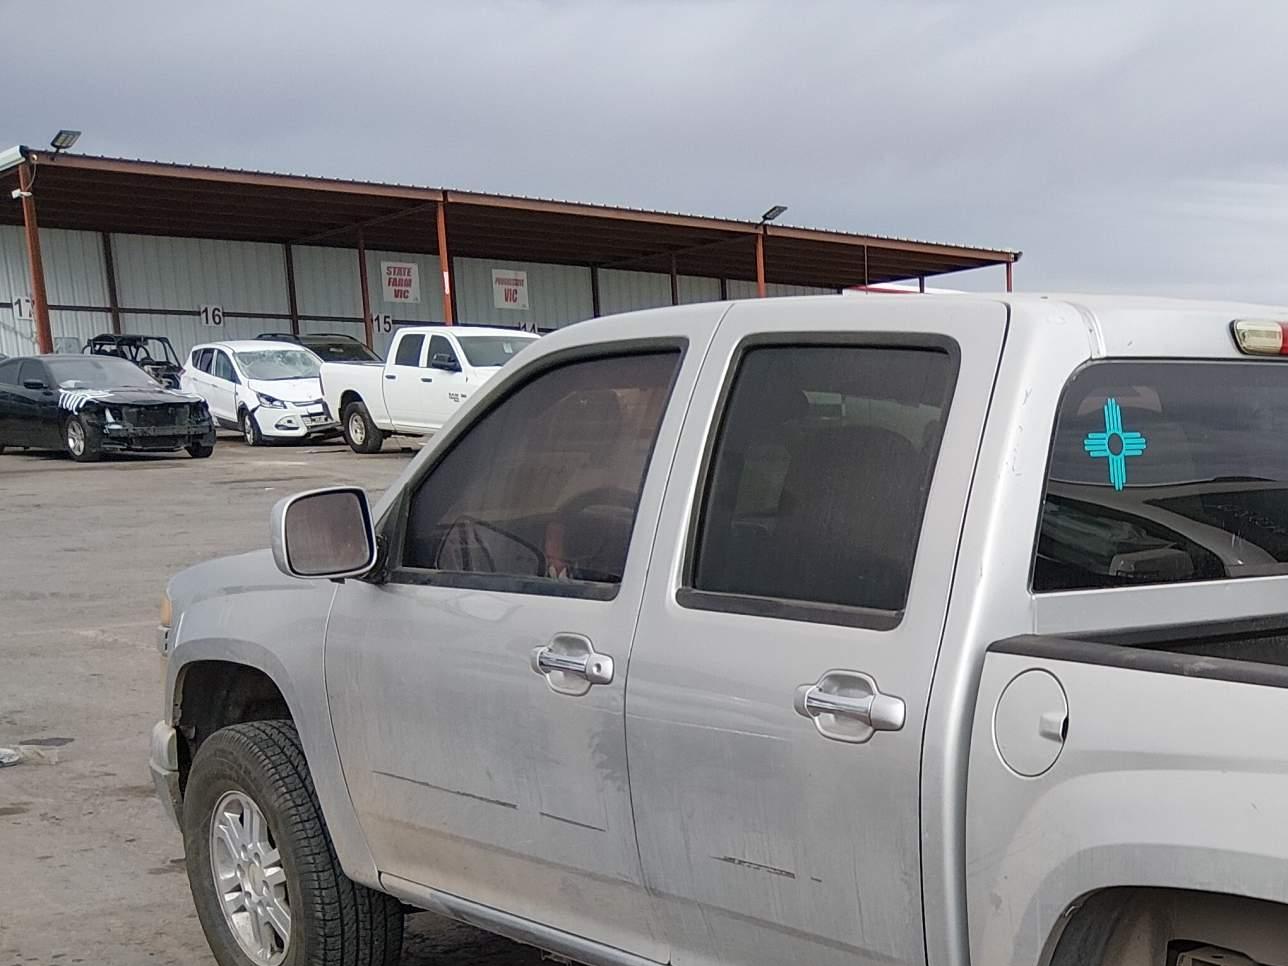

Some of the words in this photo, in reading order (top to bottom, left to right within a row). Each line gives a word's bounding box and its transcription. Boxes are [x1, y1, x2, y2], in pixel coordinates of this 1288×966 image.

[386, 266, 412, 276] STATE
[387, 277, 412, 288] FARM
[393, 289, 410, 299] VIC
[504, 288, 518, 303] VIC
[201, 306, 222, 325] 16
[374, 314, 392, 333] 15
